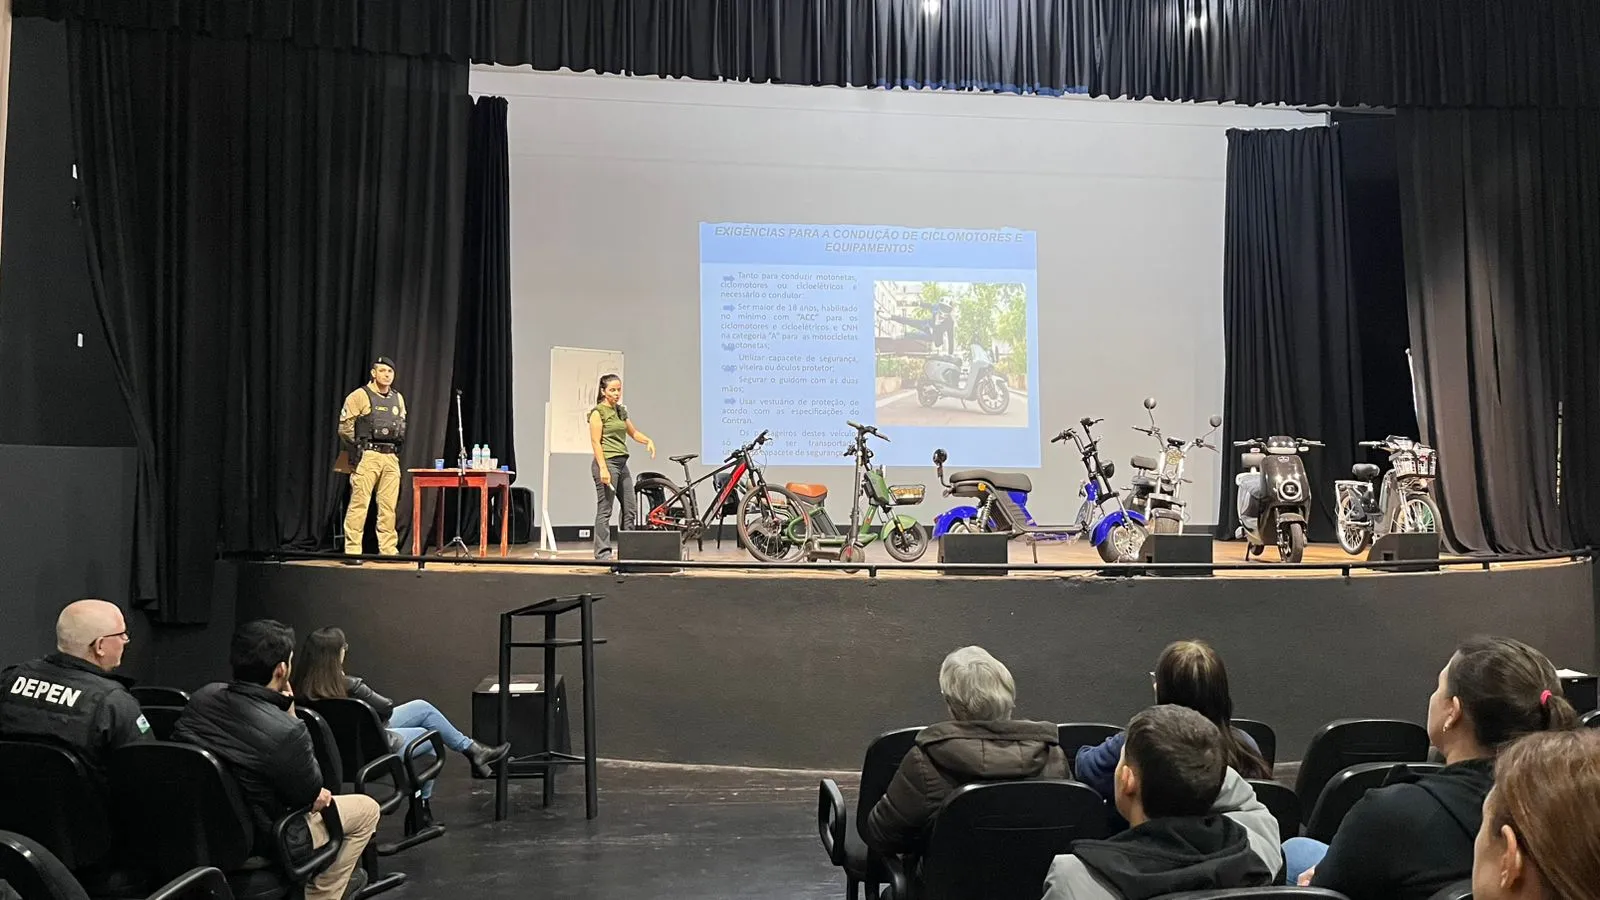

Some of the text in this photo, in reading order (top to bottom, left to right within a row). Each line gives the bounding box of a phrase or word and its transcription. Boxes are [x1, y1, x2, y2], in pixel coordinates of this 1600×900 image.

[715, 225, 785, 237] EXIGÊNCIAS
[788, 229, 820, 238] PARA
[833, 229, 898, 241] CONDUÇÃO
[902, 231, 918, 240] DE
[921, 231, 1011, 242] CICLOMOTORES
[824, 242, 914, 253] EQUIPAMENTOS
[796, 282, 844, 290] cicloelétricos
[822, 304, 858, 312] habilitado
[732, 332, 766, 340] categoria
[738, 376, 767, 384] Segurar
[812, 399, 846, 407] proteção,
[792, 408, 843, 416] especificações
[10, 676, 82, 708] DEPEN
